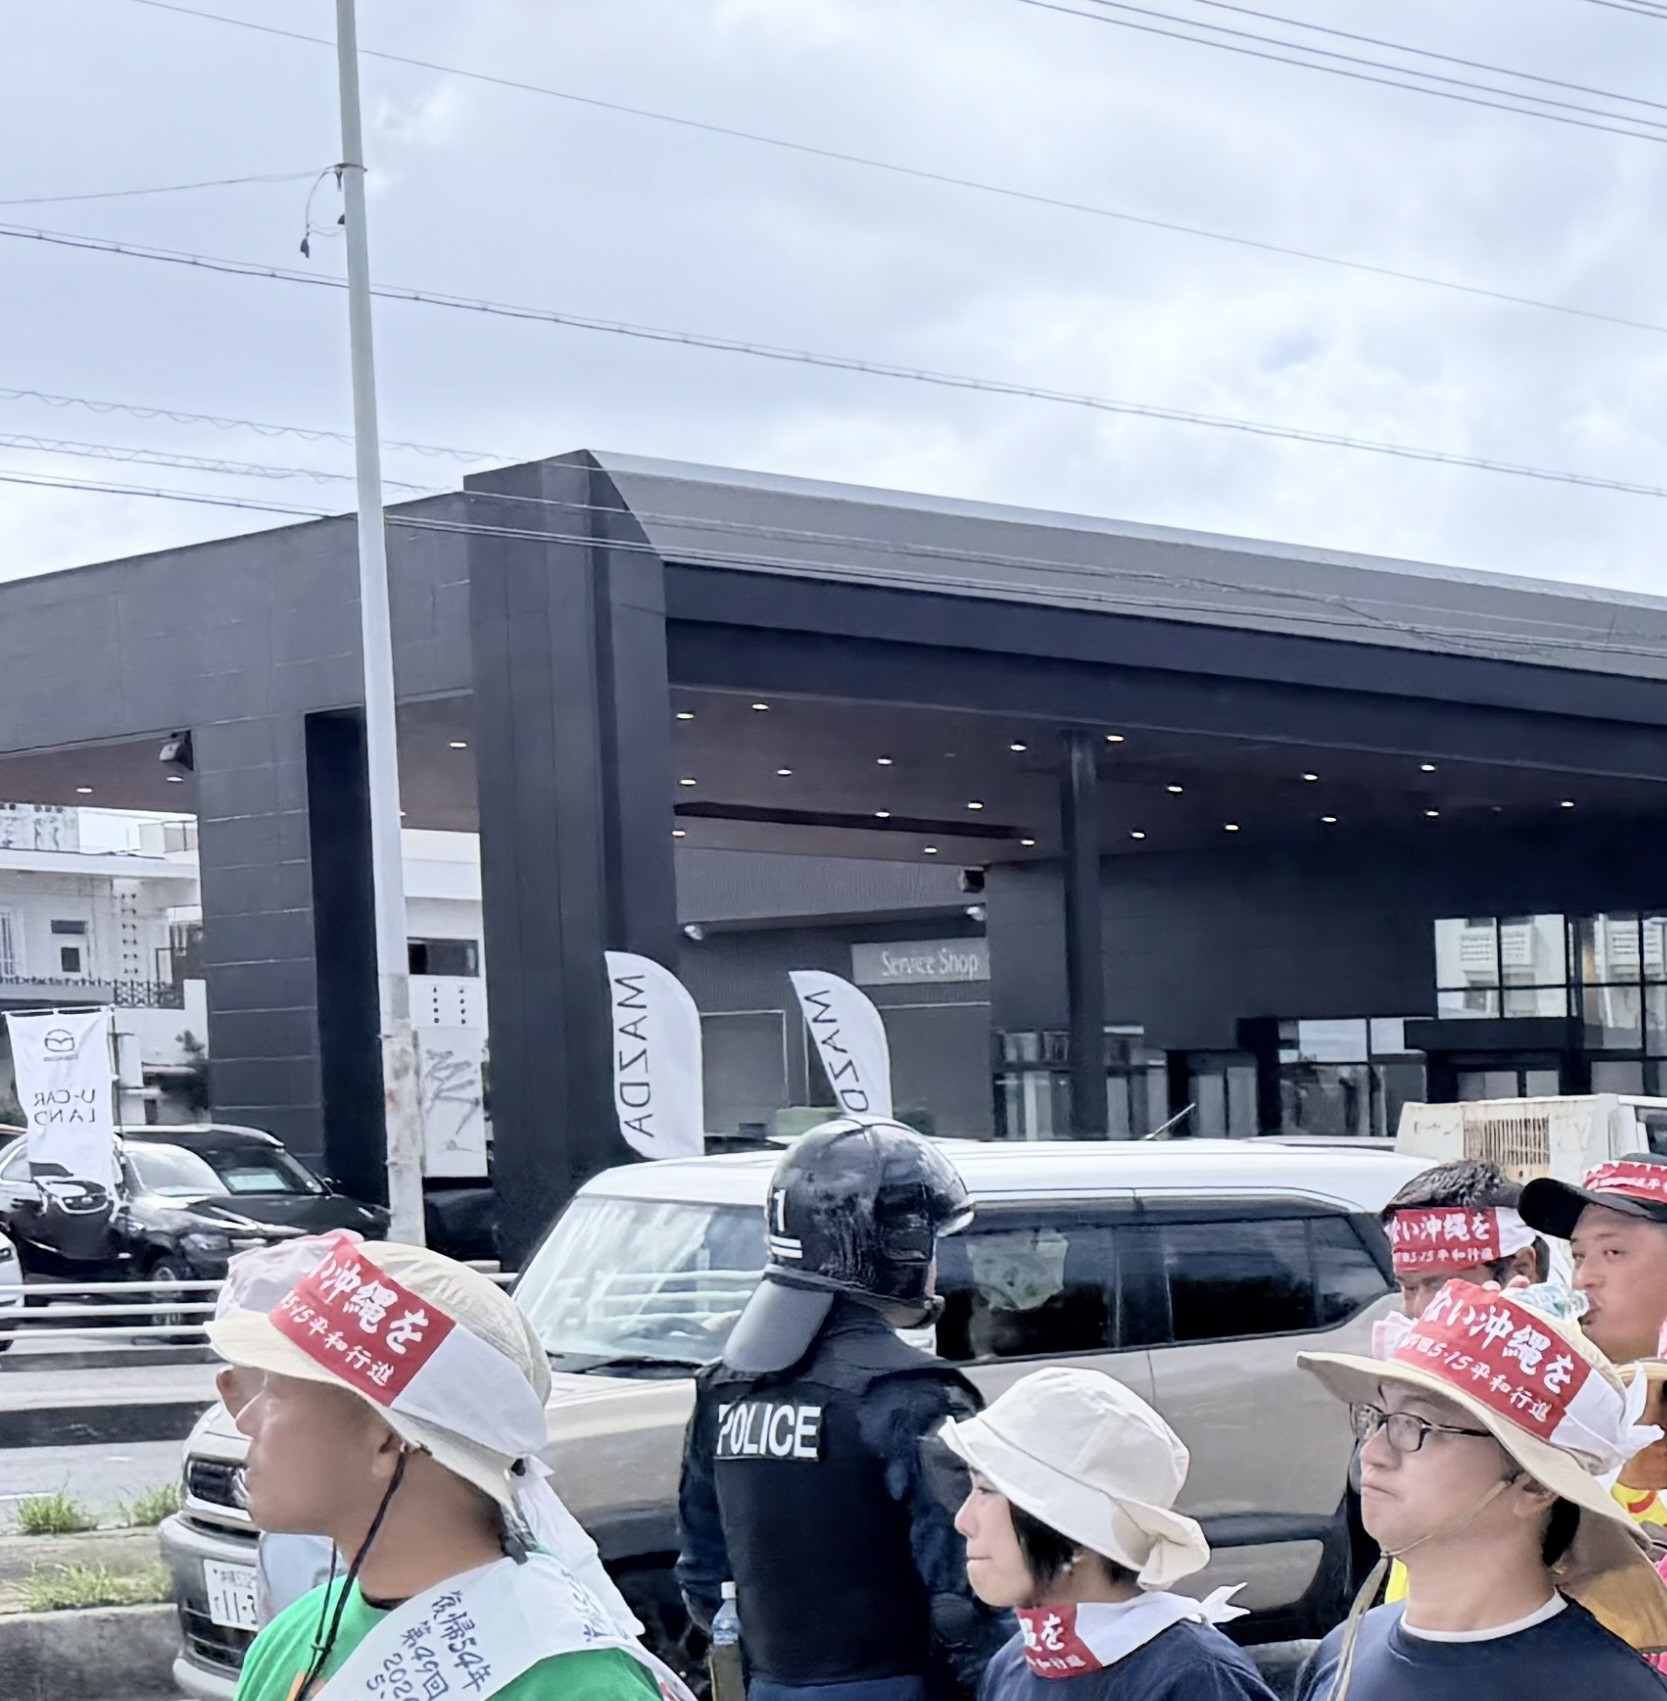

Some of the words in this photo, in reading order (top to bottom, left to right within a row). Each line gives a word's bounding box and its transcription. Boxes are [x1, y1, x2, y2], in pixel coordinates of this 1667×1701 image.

[938, 947, 979, 977] Shop
[772, 1187, 786, 1232] 1
[716, 1401, 823, 1458] POLICE
